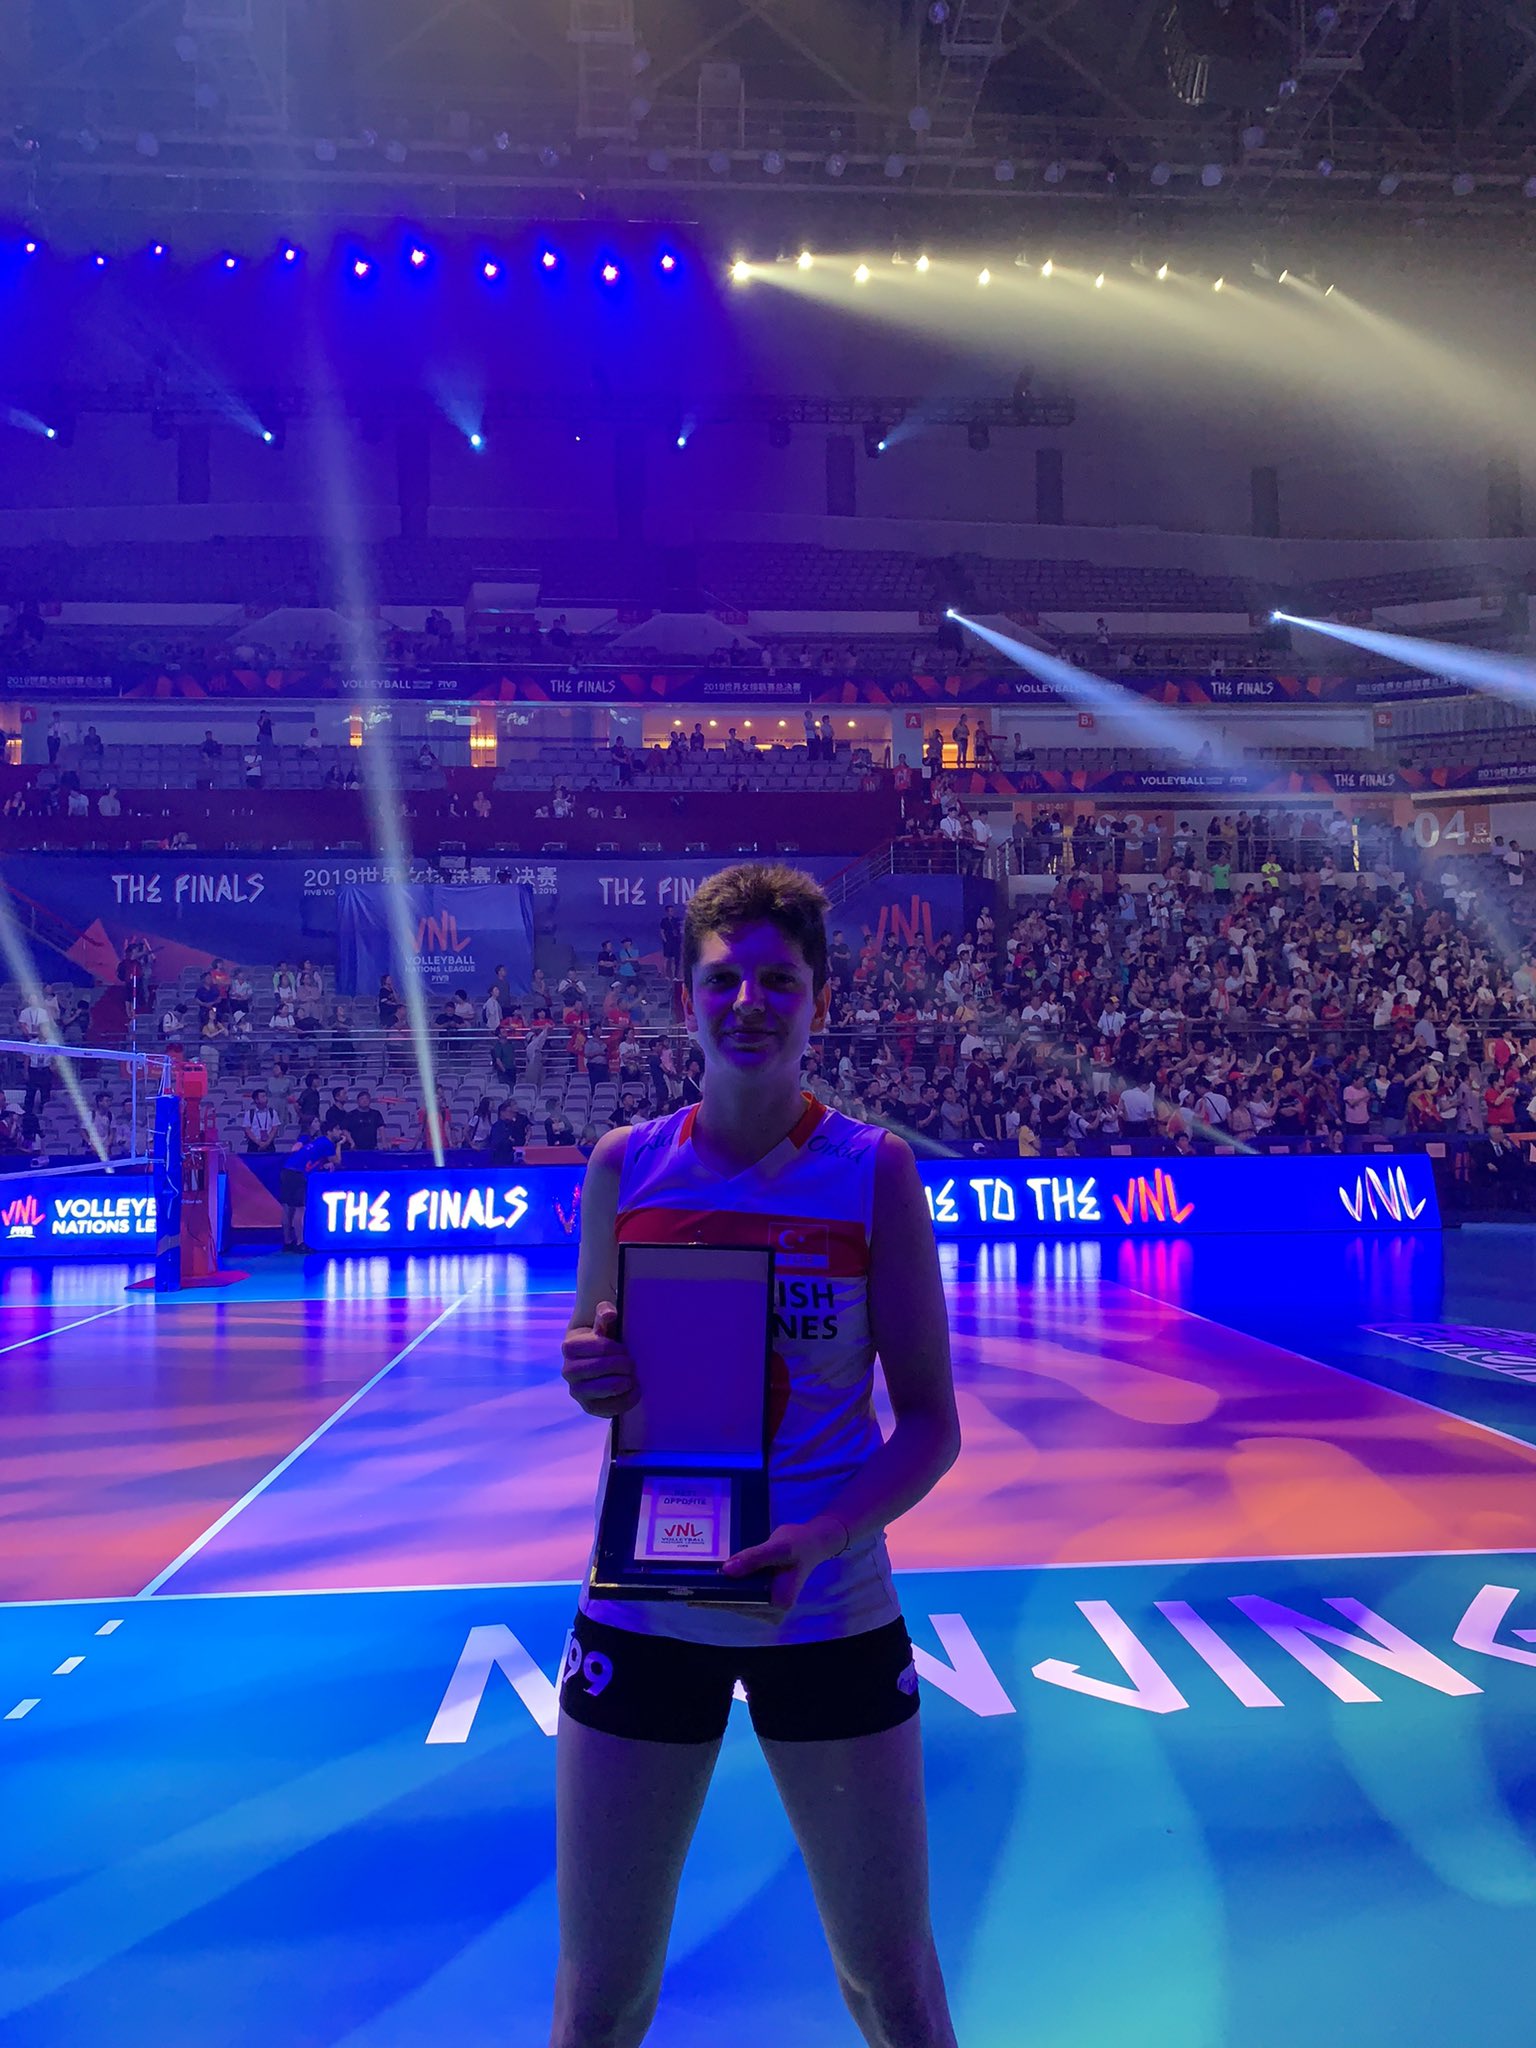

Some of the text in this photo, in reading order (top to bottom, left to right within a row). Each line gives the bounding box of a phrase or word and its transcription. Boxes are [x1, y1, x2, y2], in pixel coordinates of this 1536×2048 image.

[342, 680, 410, 690] VOLLEYBALL
[550, 680, 616, 693] THE FINALS
[1211, 681, 1274, 695] THE FINALS
[24, 710, 33, 720] A
[908, 715, 919, 726] A
[1141, 776, 1205, 786] VOLLEYBALL
[1334, 773, 1396, 787] THE FINALS
[1413, 809, 1471, 849] 04
[111, 873, 265, 904] THE FINALS
[598, 876, 708, 906] THE FIN
[411, 910, 472, 953] VNL
[405, 955, 476, 965] VOLLEYBALL
[443, 965, 476, 973] LEAGUE
[807, 1134, 872, 1164] Orkid
[969, 1177, 1016, 1222] TO
[1026, 1176, 1101, 1222] THE
[1112, 1167, 1195, 1225] VNL
[1338, 1165, 1427, 1222] VNL
[1, 1194, 46, 1226] VNL
[322, 1184, 528, 1233] THE FINALS
[52, 1219, 130, 1235] NATIONS
[777, 1281, 835, 1309] ISH
[771, 1313, 838, 1340] NES
[664, 1522, 704, 1537] VNL
[563, 1638, 614, 1697] 99
